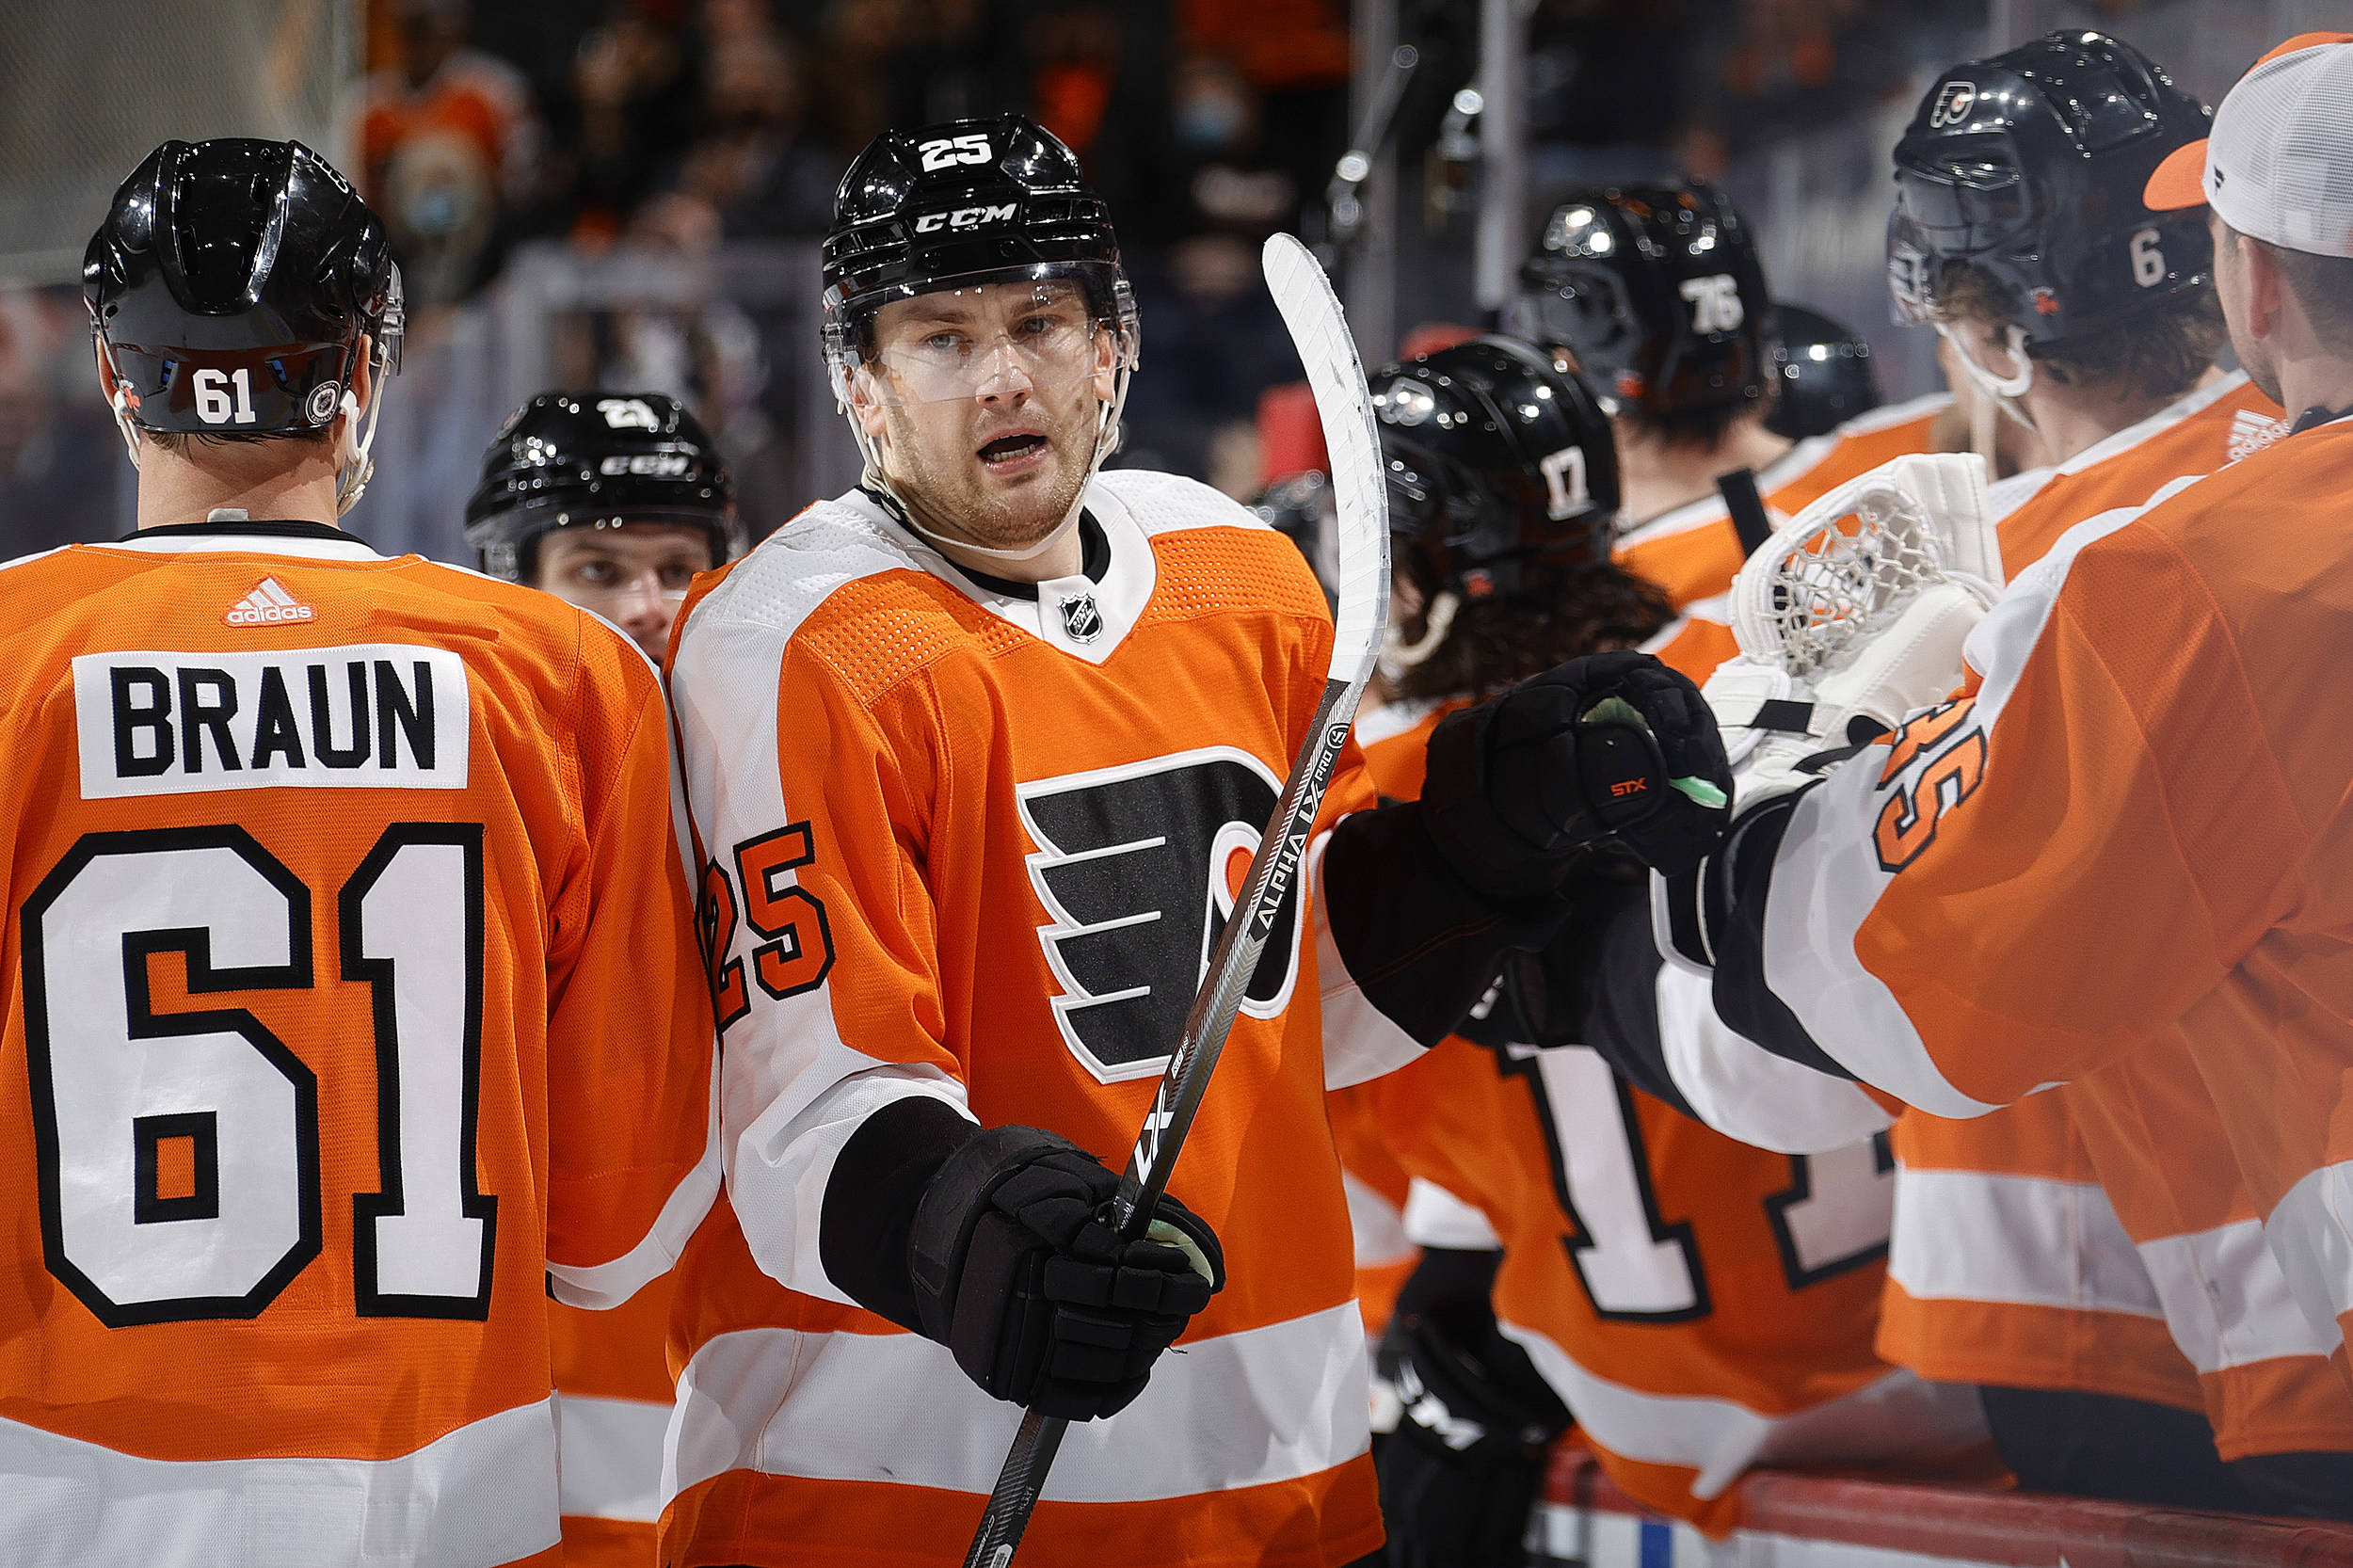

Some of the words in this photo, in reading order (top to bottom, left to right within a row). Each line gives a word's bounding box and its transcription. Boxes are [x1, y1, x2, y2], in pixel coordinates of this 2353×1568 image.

[919, 134, 992, 172] 25
[916, 203, 1016, 232] CCM
[2129, 229, 2166, 288] 6
[1678, 273, 1744, 334] 76
[192, 368, 256, 424] 61
[1540, 445, 1592, 517] 17
[227, 605, 312, 623] adidas
[110, 660, 437, 778] BRAUN
[1257, 833, 1307, 930] ALPHA
[1298, 780, 1325, 824] LX
[1315, 752, 1333, 782] PRO
[694, 821, 836, 1034] 25
[20, 823, 498, 1329] 61
